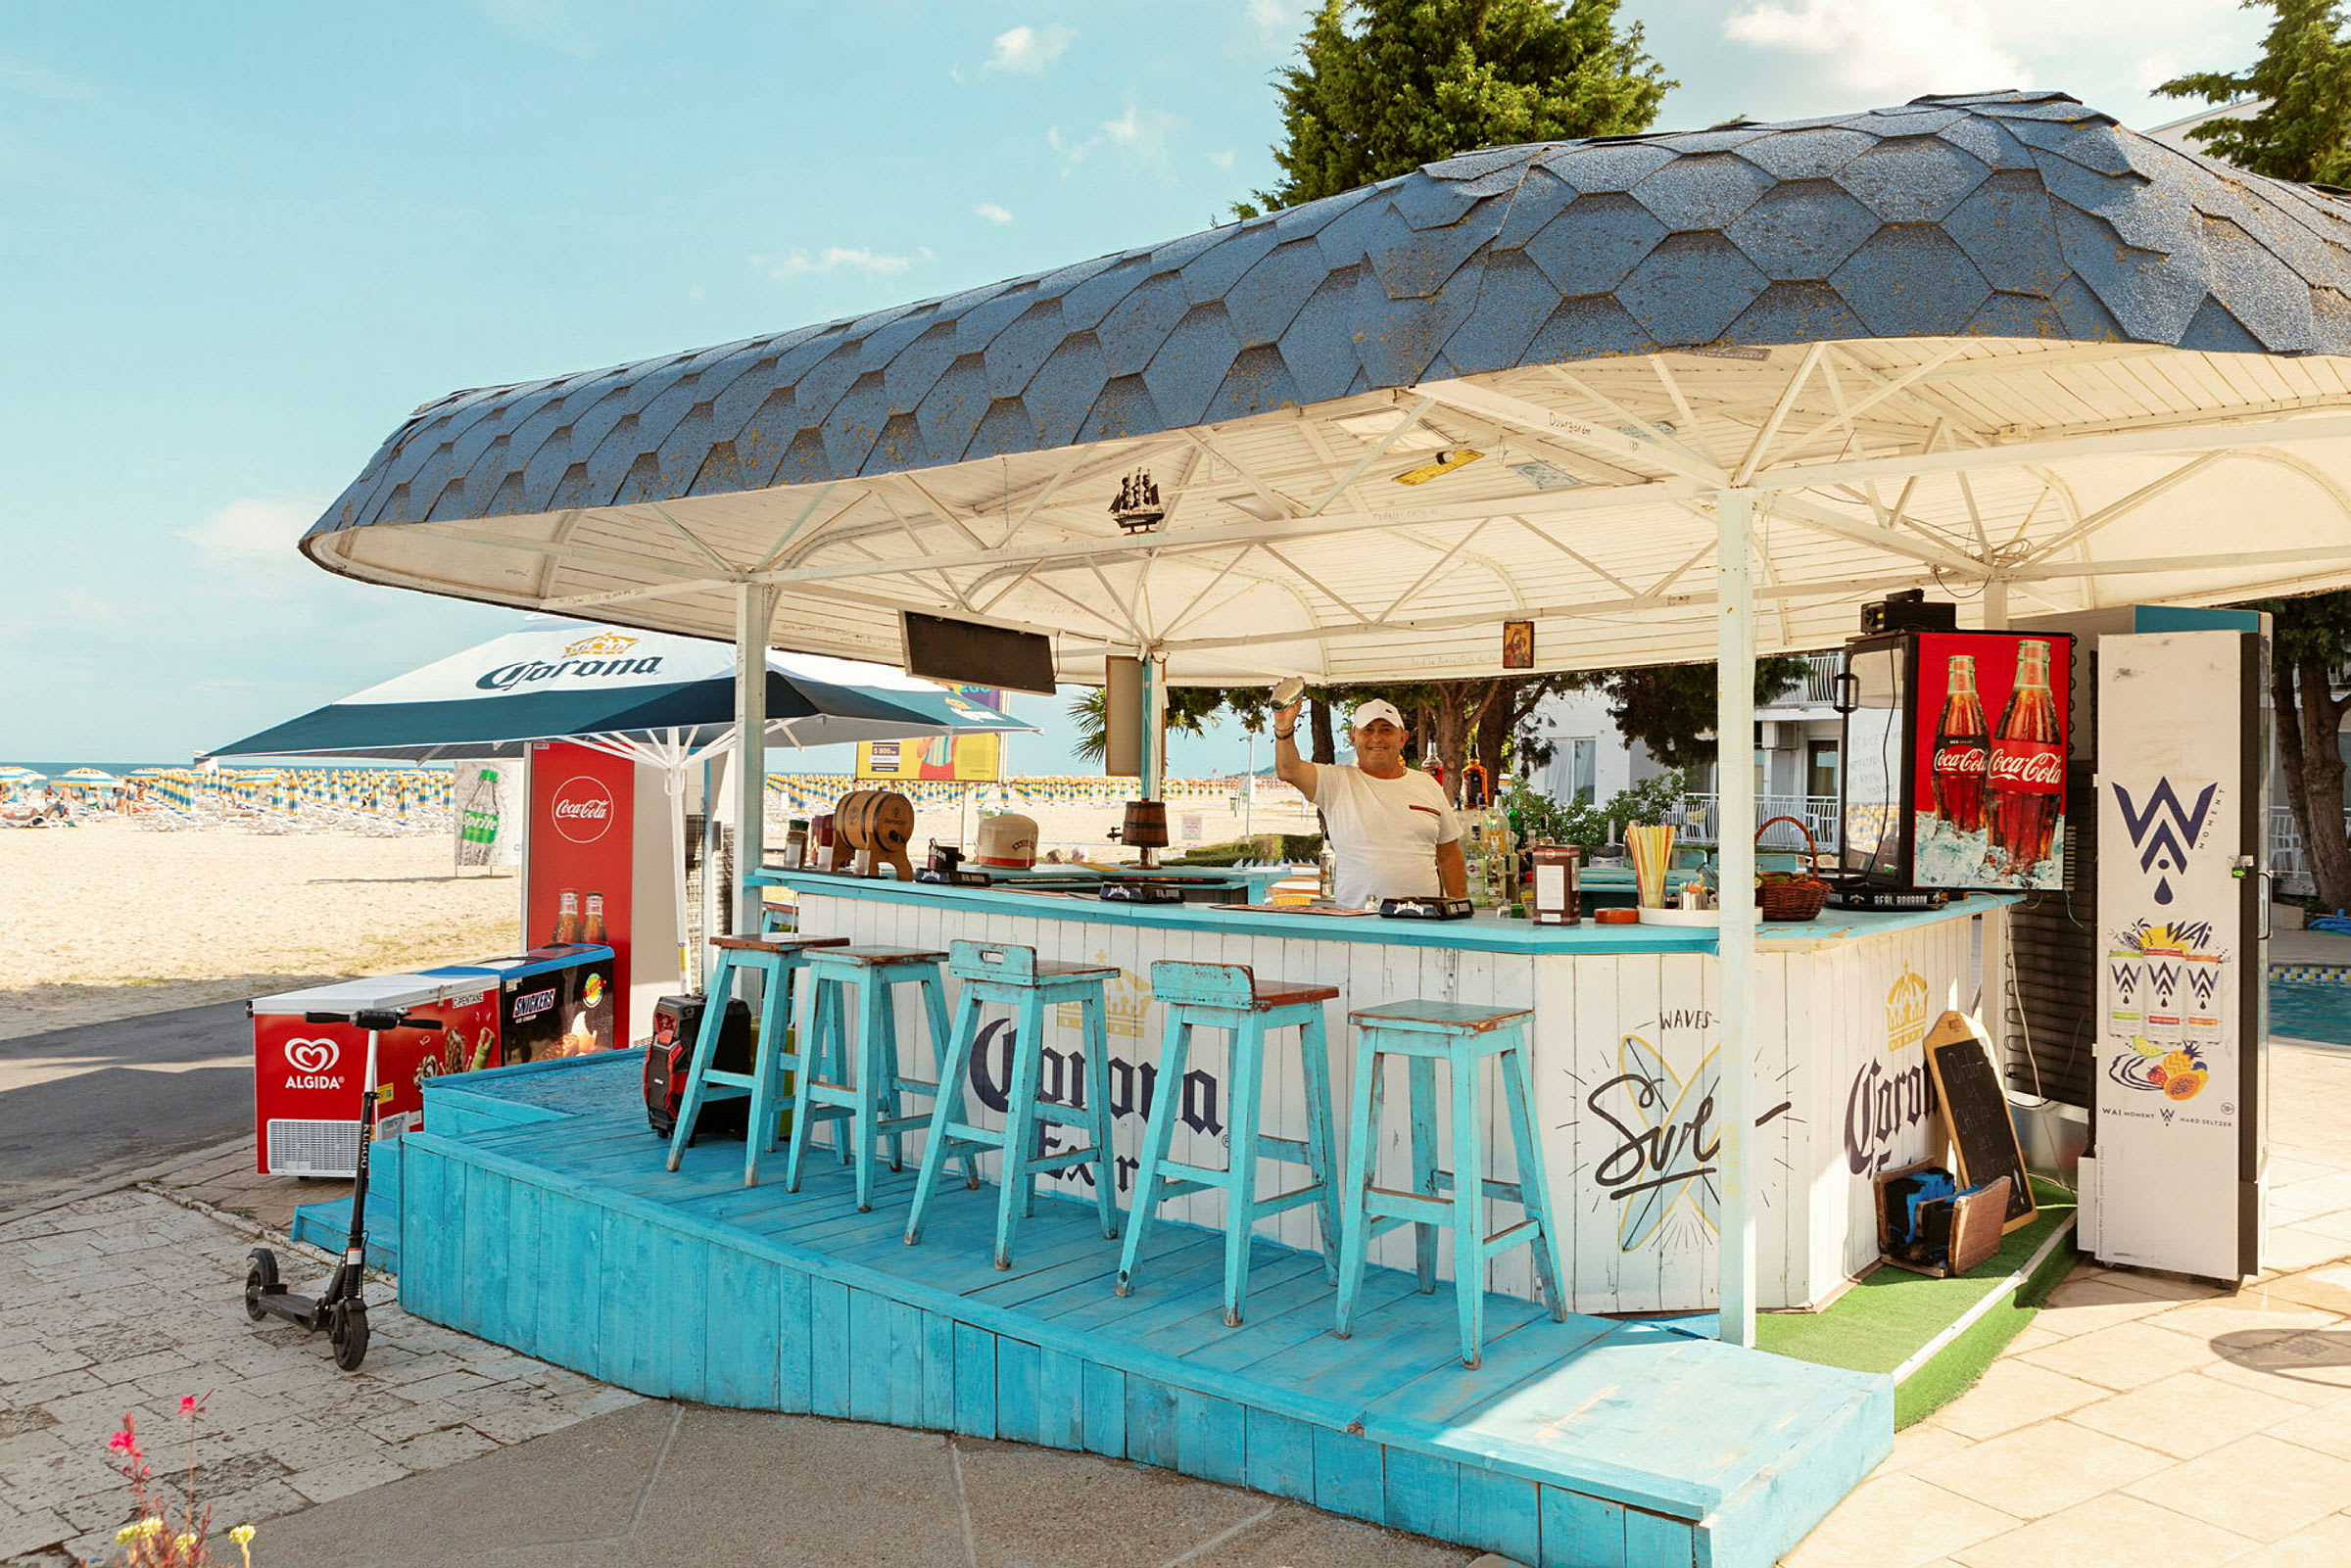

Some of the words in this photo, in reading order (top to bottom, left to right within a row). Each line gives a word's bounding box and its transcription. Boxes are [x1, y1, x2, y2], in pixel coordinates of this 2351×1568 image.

[476, 655, 664, 691] Corona
[1988, 747, 2062, 784] Coca-Cola
[463, 812, 498, 832] Sprite
[555, 798, 610, 820] Coca-Cola
[514, 988, 556, 1018] SNICKERS
[1659, 1009, 1712, 1029] WAVES
[285, 1075, 341, 1090] ALGIDA
[1587, 1073, 1792, 1186] Sur
[1844, 1057, 1939, 1179] Coron
[360, 1122, 371, 1169] KUGOO
